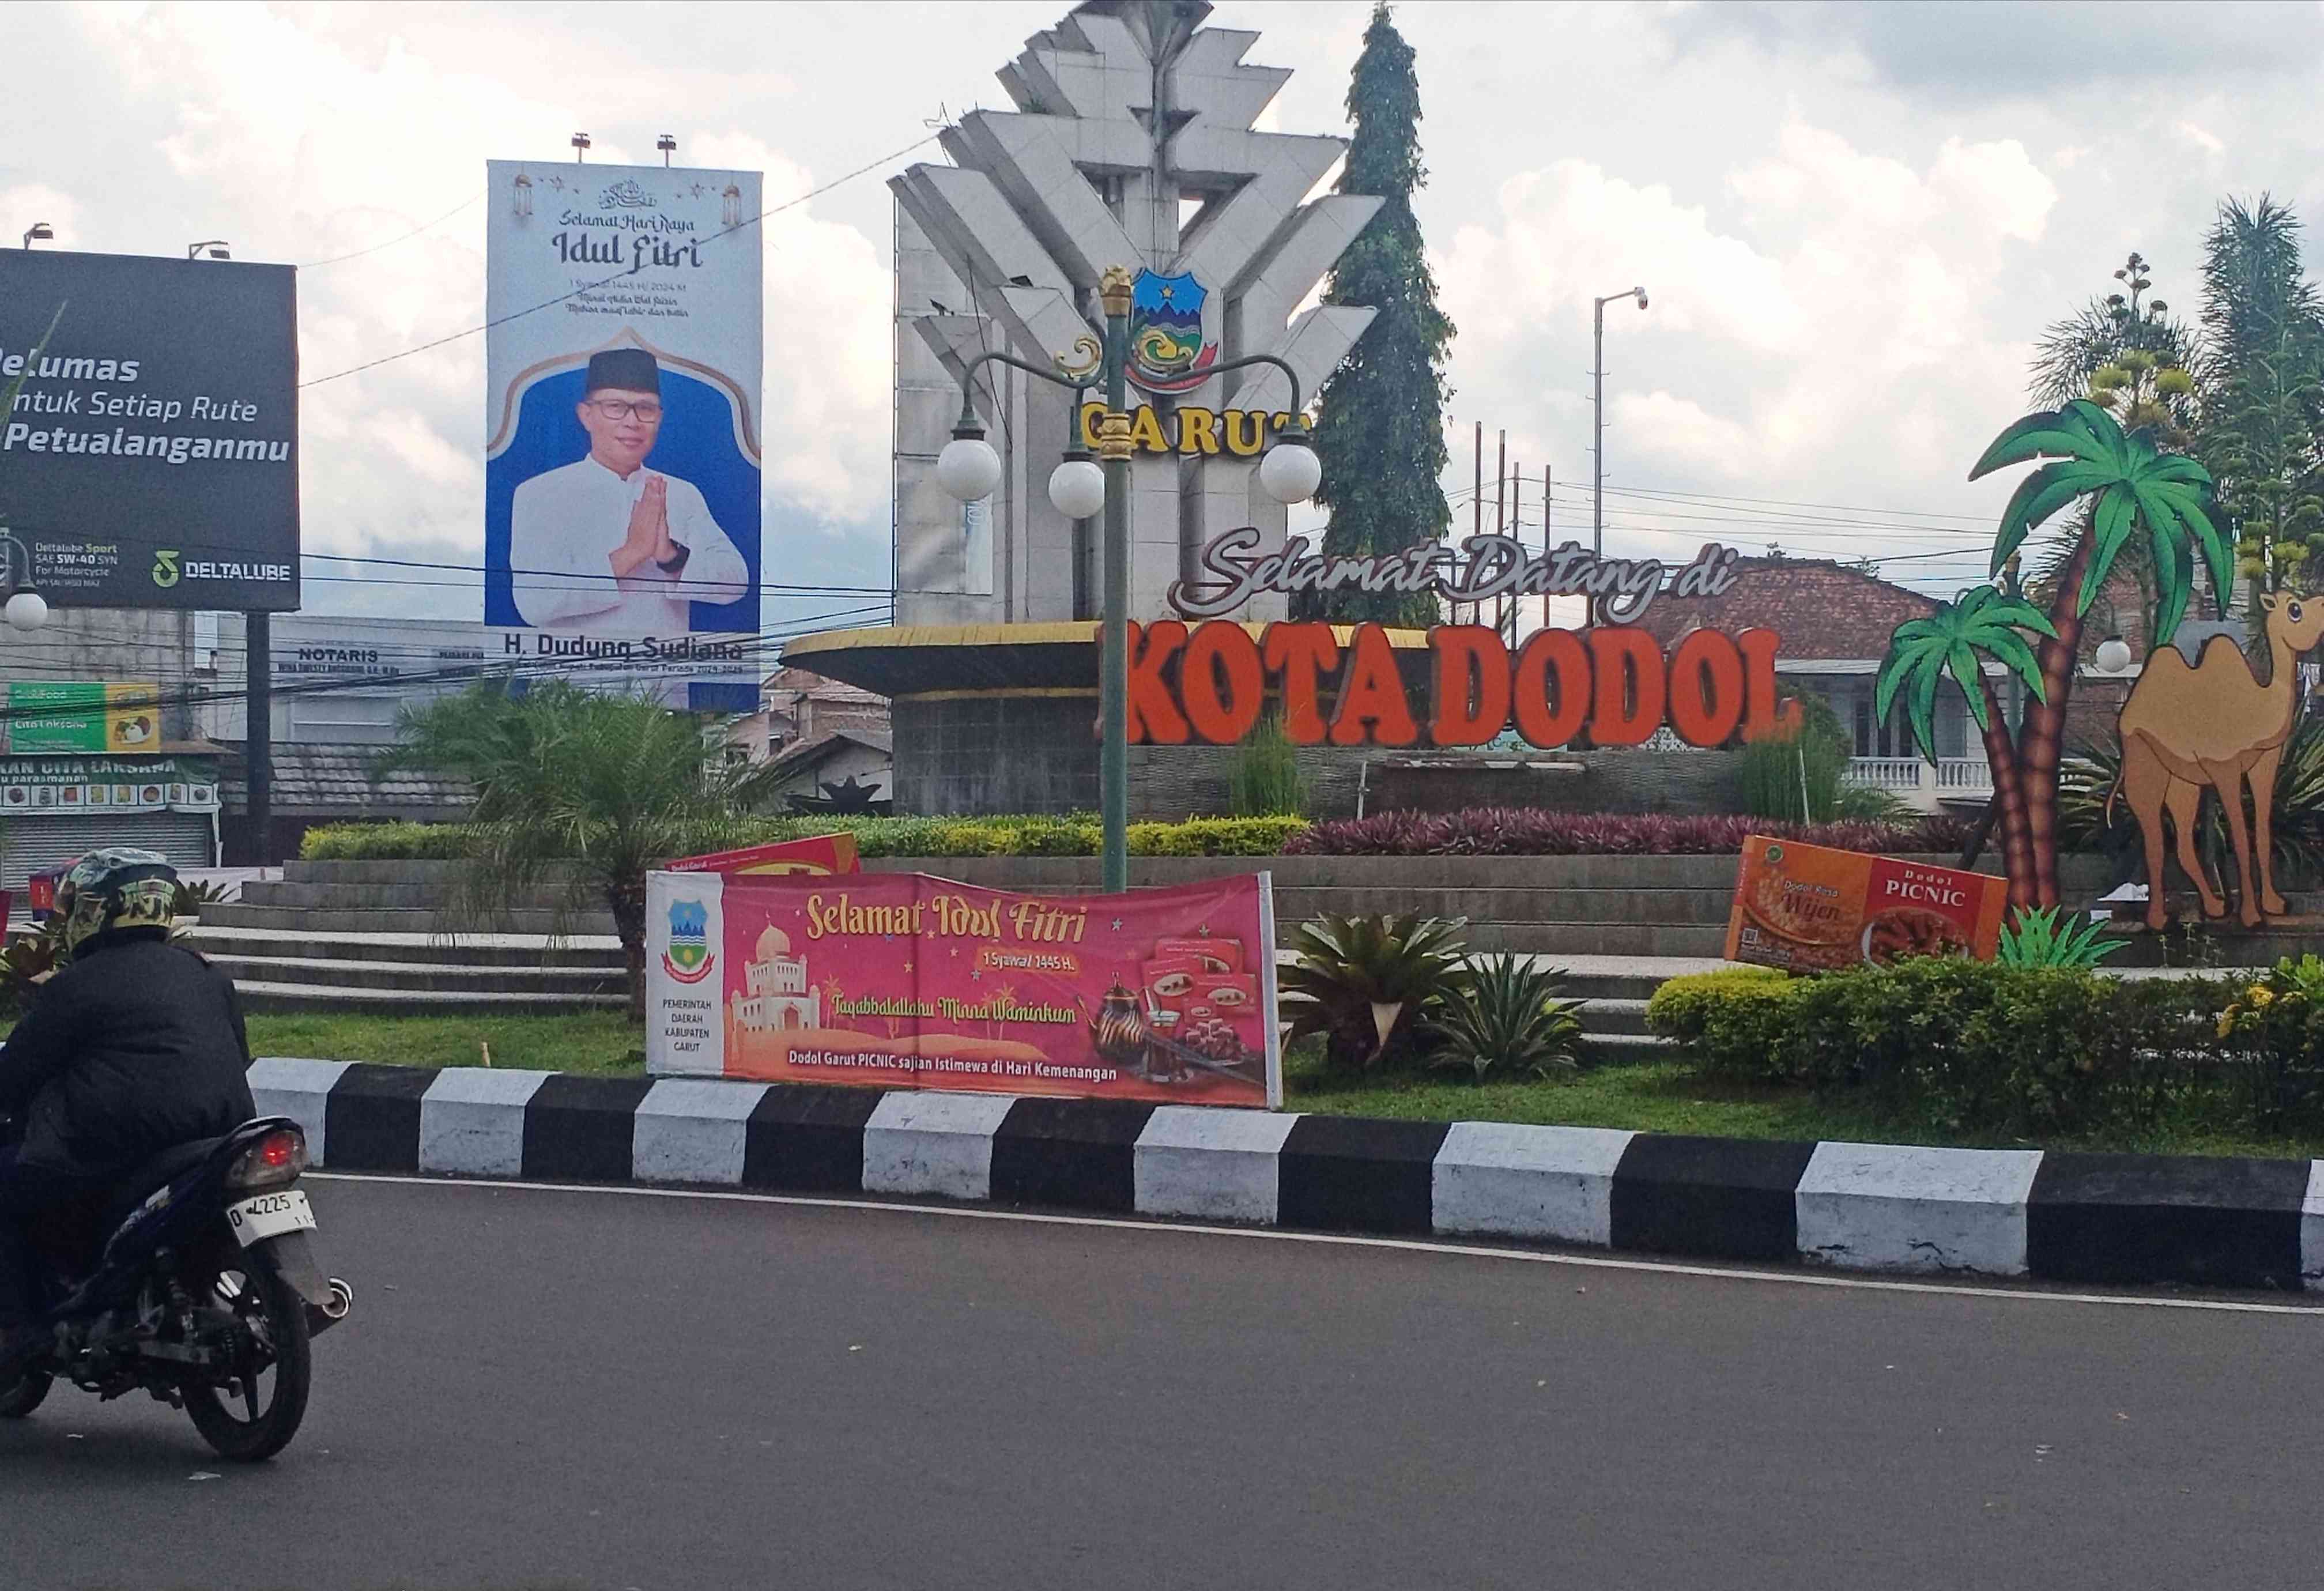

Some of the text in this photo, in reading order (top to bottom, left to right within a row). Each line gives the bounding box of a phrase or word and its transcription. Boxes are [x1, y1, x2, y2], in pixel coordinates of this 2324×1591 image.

[558, 209, 695, 233] Selamat Hari Raya
[552, 232, 703, 274] Idul Fitri
[0, 347, 141, 382] elumas
[13, 390, 258, 423] ntuk Setiap Rute
[3, 423, 289, 464] Petualanganmu
[85, 544, 118, 555] Sport
[185, 561, 291, 581] DELTALUBE
[1168, 527, 1740, 624] Selamat Datang di
[297, 649, 378, 662] NOTARIS
[505, 634, 526, 654] H.
[538, 634, 631, 661] Dudung
[1097, 620, 1805, 749] KOTA DODOL
[1904, 869, 1953, 886] Dodol
[1885, 879, 1966, 907] PICNIC
[806, 893, 1088, 943] Selamat Idul Fitri
[991, 952, 1032, 970] Syawal
[1035, 955, 1061, 970] 1445
[662, 999, 712, 1010] PEMERINTAH
[937, 996, 990, 1024] Minna
[992, 1001, 1077, 1024] Waminkum
[671, 1013, 703, 1024] DAERAH
[665, 1027, 710, 1038] KABUPATEN
[673, 1042, 701, 1052] GARUT
[788, 1050, 1117, 1083] Dodol Garut PICNIC sajian Istimewa di Hari Kemenangan
[230, 1208, 243, 1228] D
